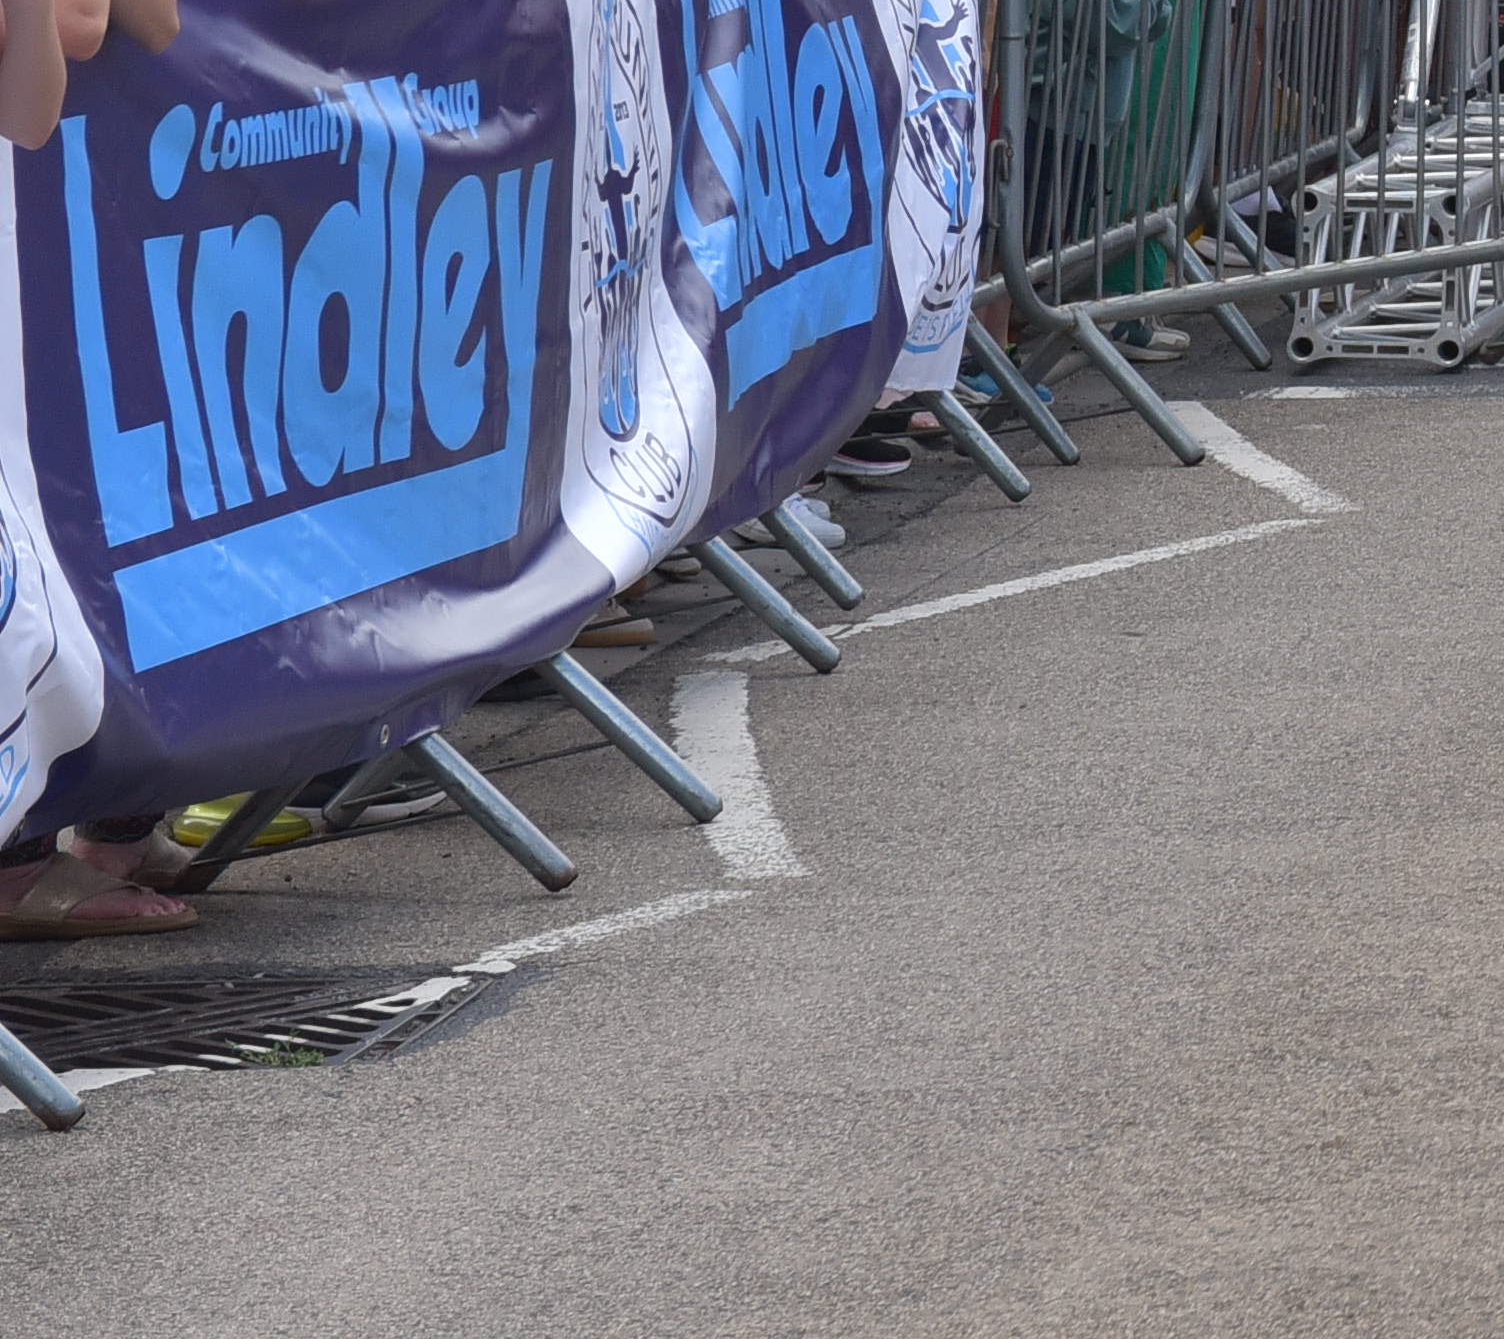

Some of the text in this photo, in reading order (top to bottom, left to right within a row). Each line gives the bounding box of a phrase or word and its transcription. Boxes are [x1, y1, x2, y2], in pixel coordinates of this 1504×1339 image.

[199, 72, 481, 172] Community Group
[60, 75, 552, 551] Lindley
[609, 430, 682, 508] CLUB
